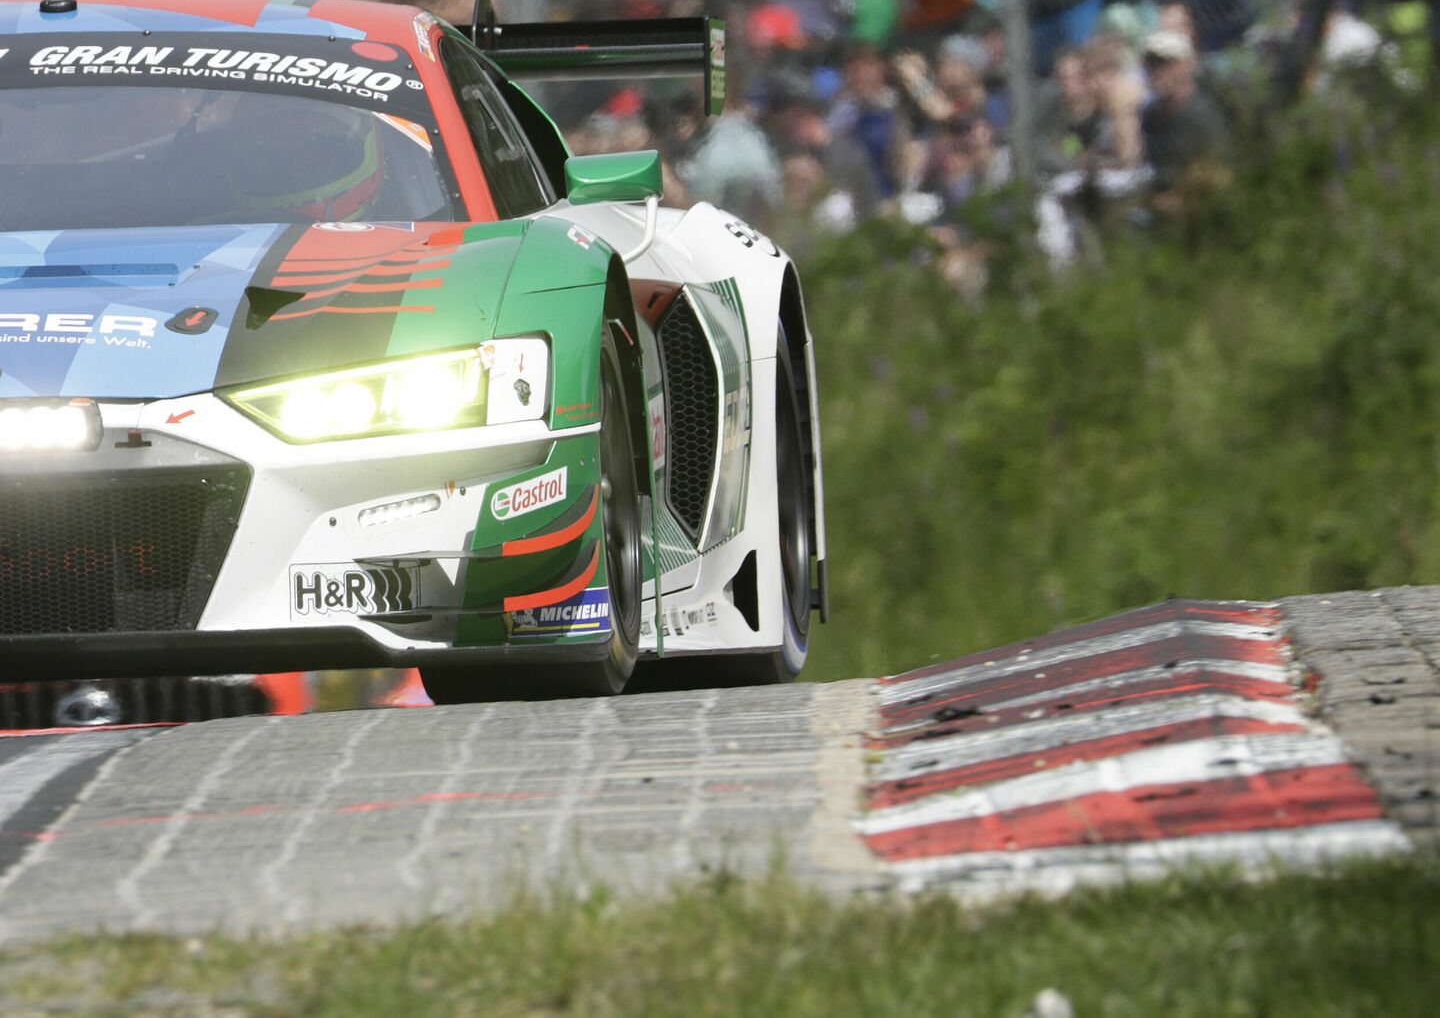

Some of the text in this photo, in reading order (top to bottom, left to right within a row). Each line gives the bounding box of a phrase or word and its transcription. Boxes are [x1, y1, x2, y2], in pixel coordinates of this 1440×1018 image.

[29, 46, 405, 92] GRAN TURISMO
[30, 65, 389, 102] THE REAL DRIVING SIMULATOR
[36, 335, 97, 346] unsere
[104, 336, 153, 350] Welt.
[509, 477, 564, 514] Castrol
[295, 571, 370, 613] H&R
[539, 601, 610, 623] MICHELIN
